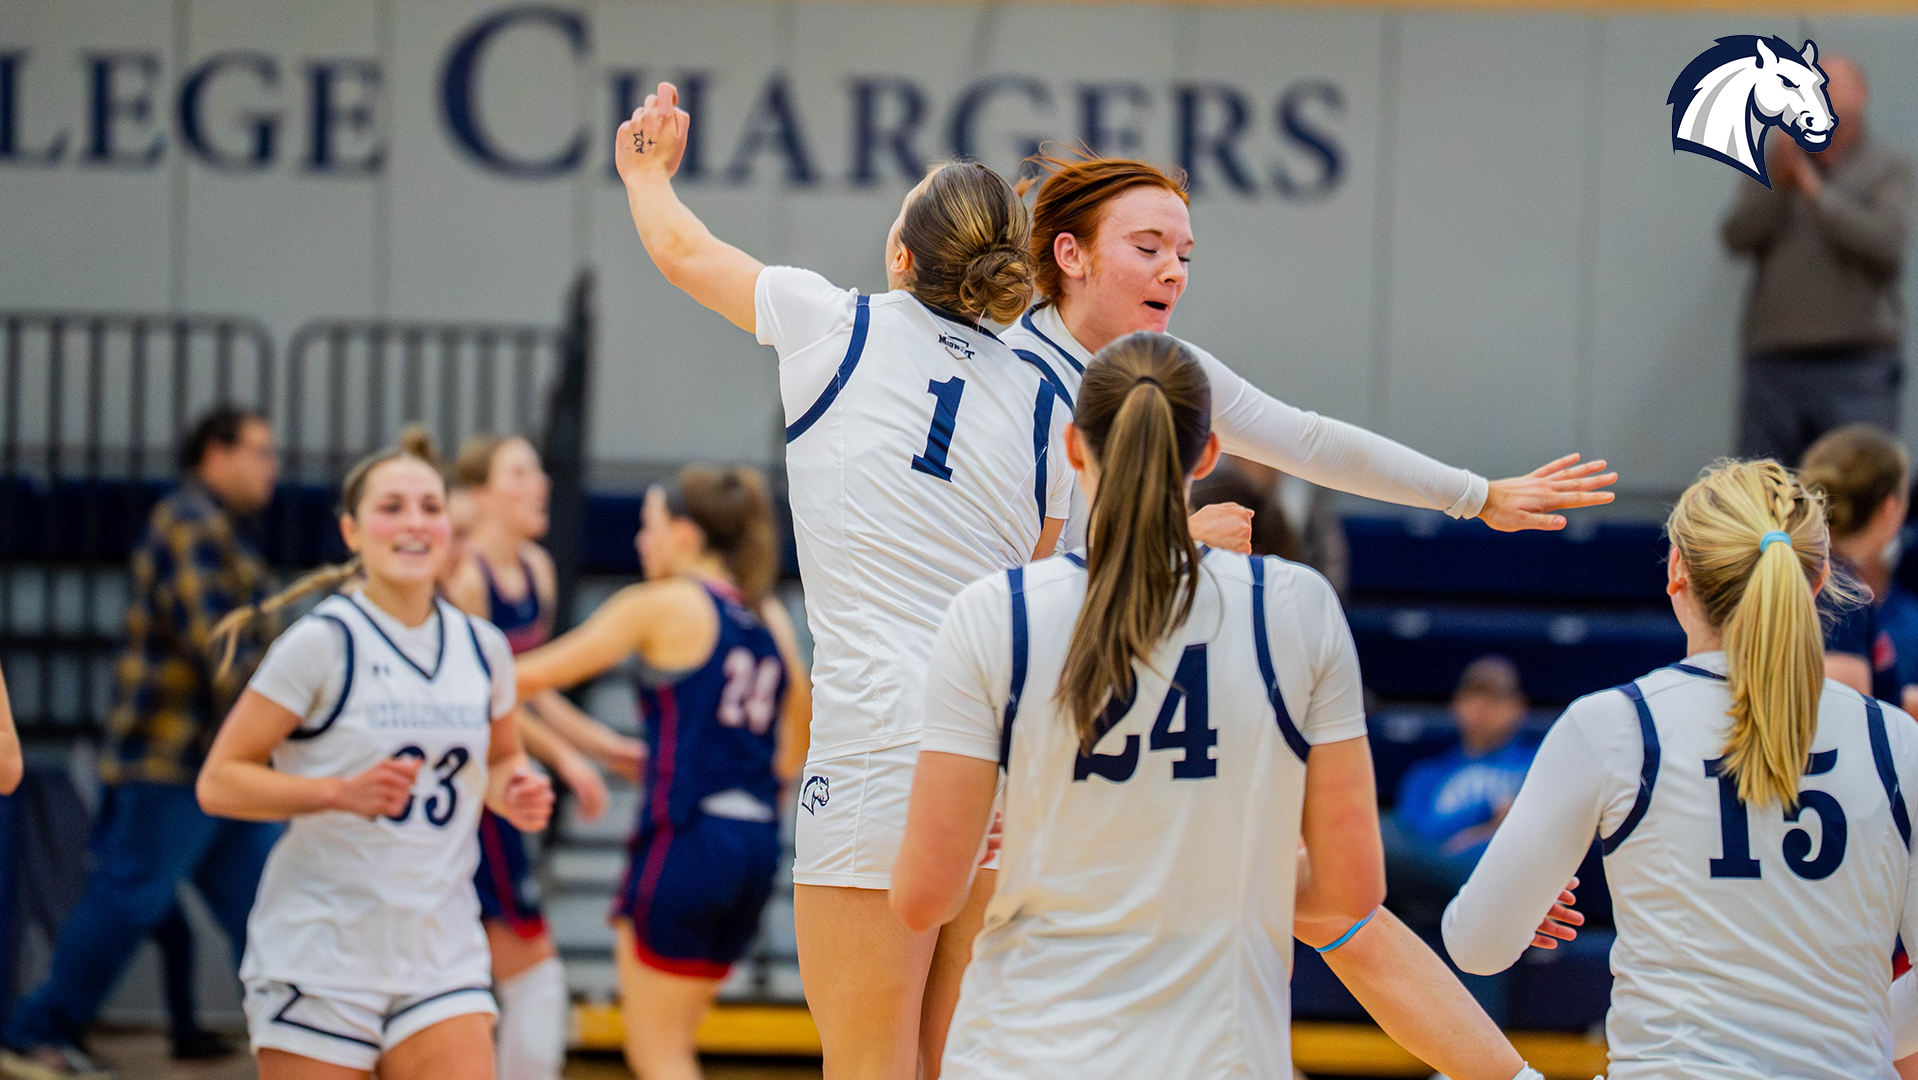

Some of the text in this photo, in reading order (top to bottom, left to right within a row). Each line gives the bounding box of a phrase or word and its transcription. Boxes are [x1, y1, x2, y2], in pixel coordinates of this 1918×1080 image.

[437, 4, 1348, 204] CHARGERS
[911, 375, 965, 482] 1
[1072, 642, 1217, 783] 24
[1702, 748, 1847, 880] 15
